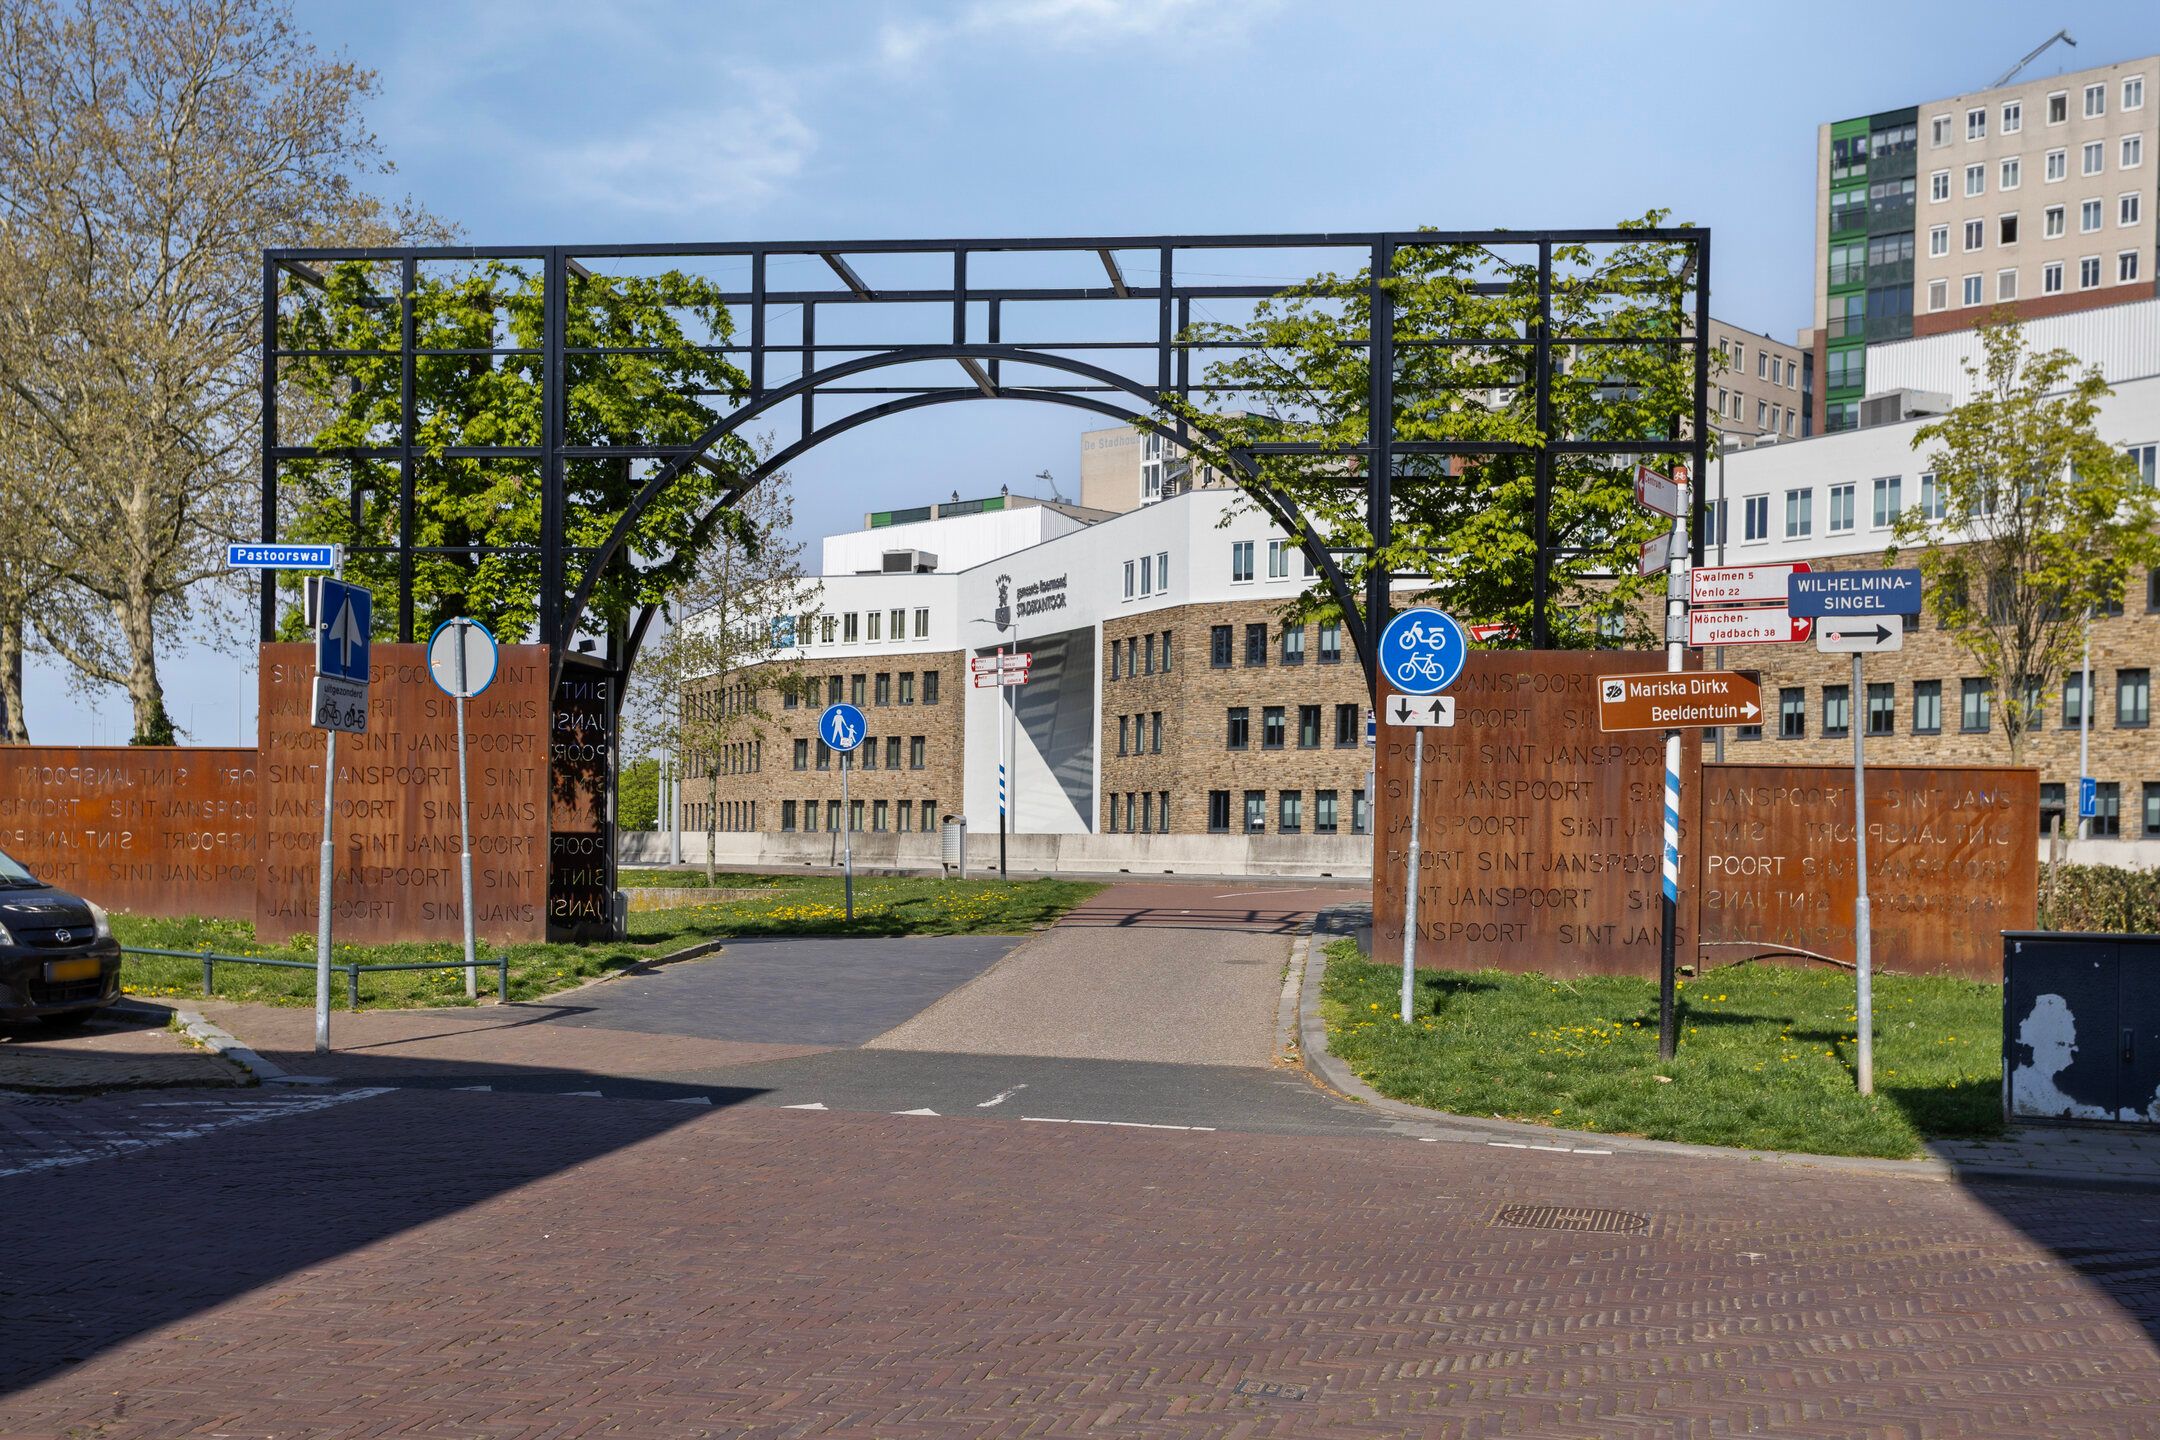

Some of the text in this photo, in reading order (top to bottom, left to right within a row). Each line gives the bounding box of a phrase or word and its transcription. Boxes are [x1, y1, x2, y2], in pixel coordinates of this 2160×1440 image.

[237, 549, 324, 562] Pastoorswal
[1695, 571, 1754, 583] Swalmen 5
[1797, 576, 1912, 593] WILHELMINA-
[1694, 587, 1740, 598] Venlo 22
[1824, 595, 1886, 610] SINGEL
[1694, 613, 1749, 625] Mönchen-
[1709, 628, 1776, 641] gladbach 38
[270, 664, 315, 684] SIN
[323, 684, 363, 699] uitgezonderd
[1630, 679, 1729, 698] Mariska Dirkx
[424, 699, 474, 719] SINT
[481, 699, 537, 719] JANS
[1651, 704, 1738, 721] Beeldentuin
[269, 731, 537, 753] POOR SINT JANSPOORT
[1388, 743, 1465, 764] POORT
[1480, 744, 1536, 764] SINT
[269, 765, 535, 787] SINT ANSPOORT SINT
[1455, 780, 1594, 801] JANSPOORT
[1709, 787, 1851, 808] JANSPOORT
[1887, 788, 1944, 809] SINT
[110, 799, 157, 818] SINT
[423, 800, 475, 820] SINT
[480, 802, 536, 821] JANS
[1561, 816, 1619, 837] SINT
[267, 831, 536, 855] POOR SINT JANSPOORT
[108, 862, 155, 881] SINT
[1478, 851, 1535, 872] SINT
[1708, 855, 1786, 876] POORT
[268, 865, 534, 889] SINT ANSPOORT SINT
[1448, 887, 1592, 908] JANSPOORT
[422, 901, 460, 921] SIN
[478, 903, 535, 923] JANS
[1559, 924, 1617, 944] SINT
